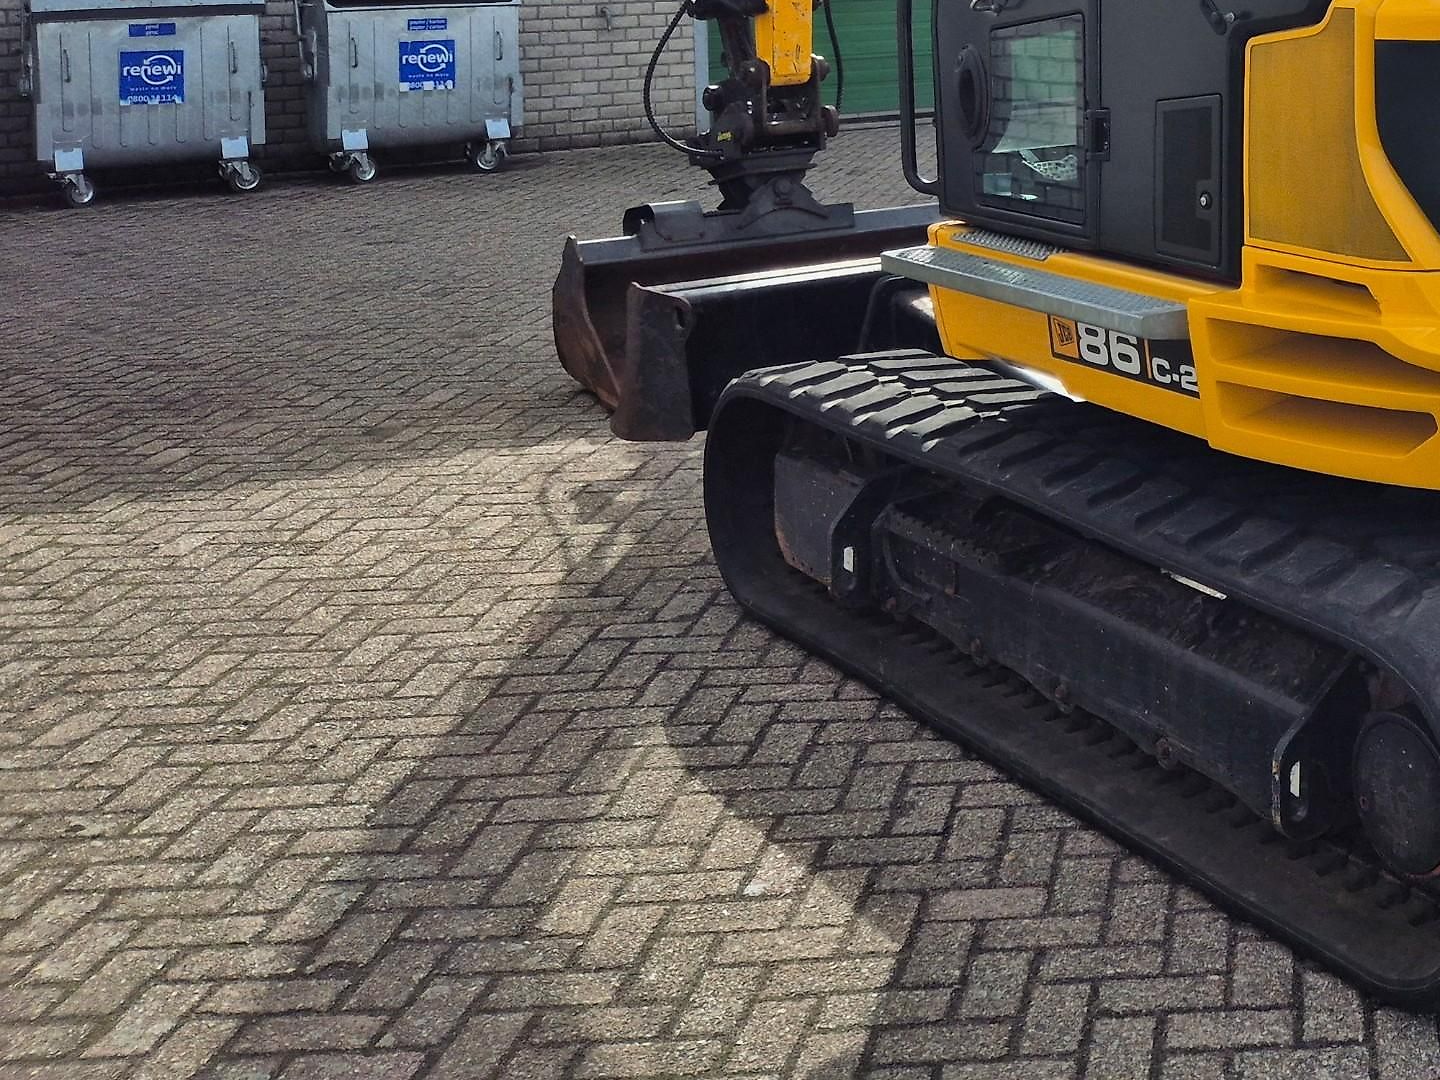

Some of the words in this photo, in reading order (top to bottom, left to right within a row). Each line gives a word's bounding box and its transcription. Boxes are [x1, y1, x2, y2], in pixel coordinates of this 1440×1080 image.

[402, 49, 453, 65] renewi
[122, 62, 182, 76] renewi
[1077, 322, 1140, 375] 86
